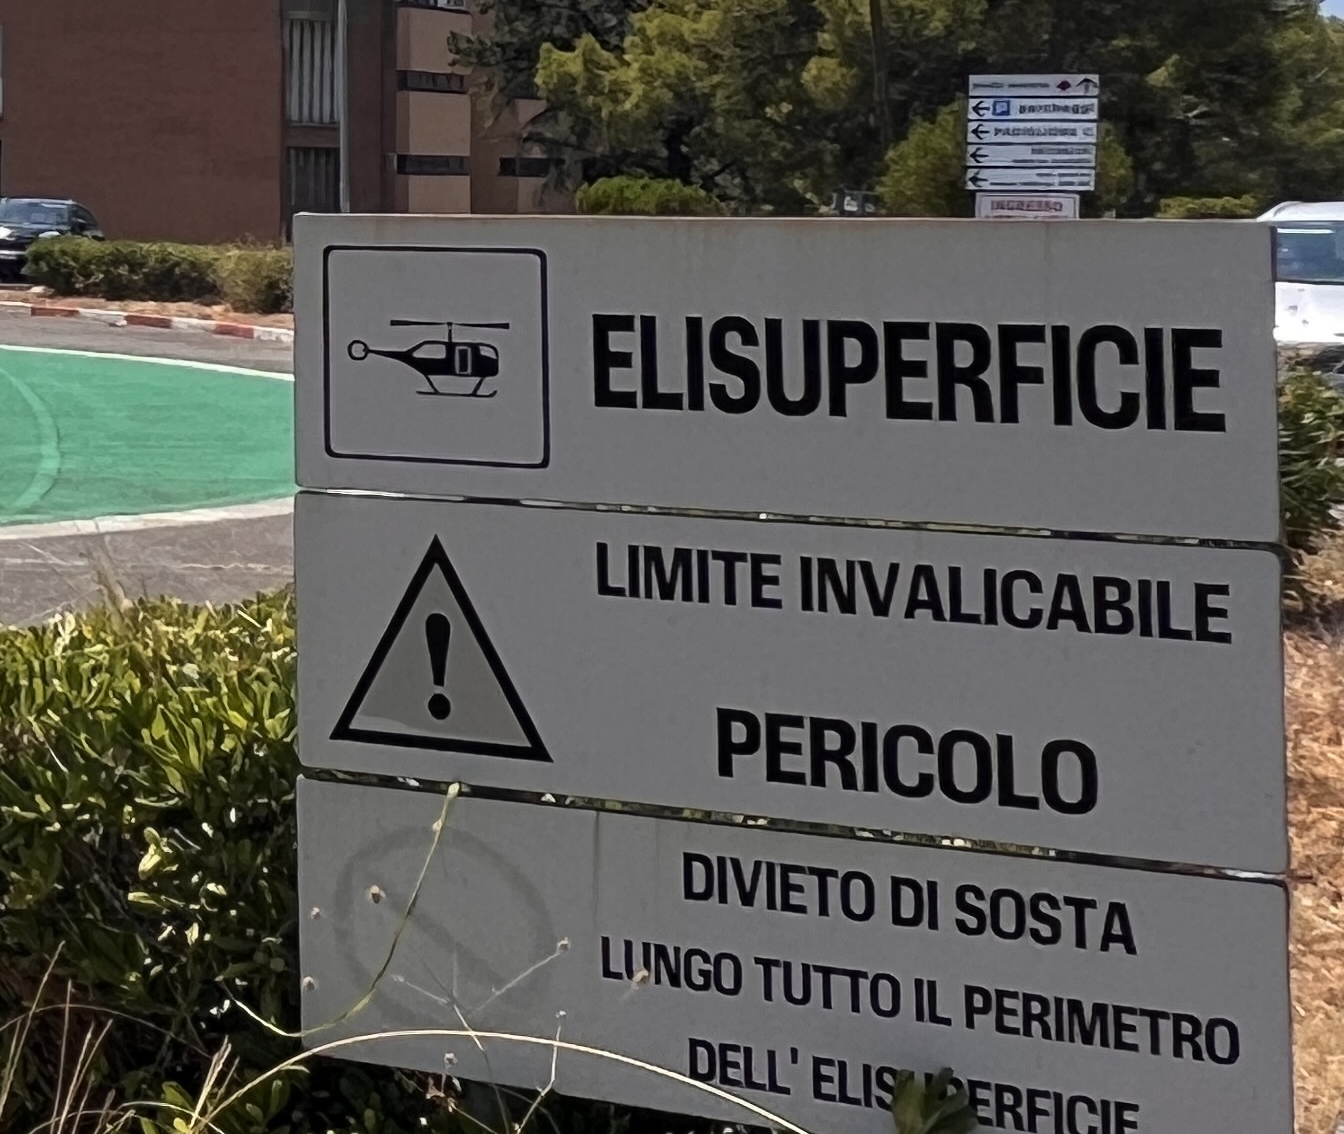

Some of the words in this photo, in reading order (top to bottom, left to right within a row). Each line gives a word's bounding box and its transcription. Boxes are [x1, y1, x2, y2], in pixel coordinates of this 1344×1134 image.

[591, 313, 1227, 433] ELISUPERFICIE
[596, 541, 783, 610] LIMITE
[799, 555, 1233, 645] INVALICABILE
[716, 706, 1099, 815] PERICOLO
[682, 851, 876, 922] DIVIETO
[890, 875, 939, 931] DI
[954, 883, 1138, 956] SOSTA
[600, 935, 743, 997] LUNGO
[753, 956, 901, 1019] TUTTO
[913, 977, 953, 1027] IL
[963, 984, 1240, 1065] PERIMETRO
[688, 1037, 799, 1096] DELL'
